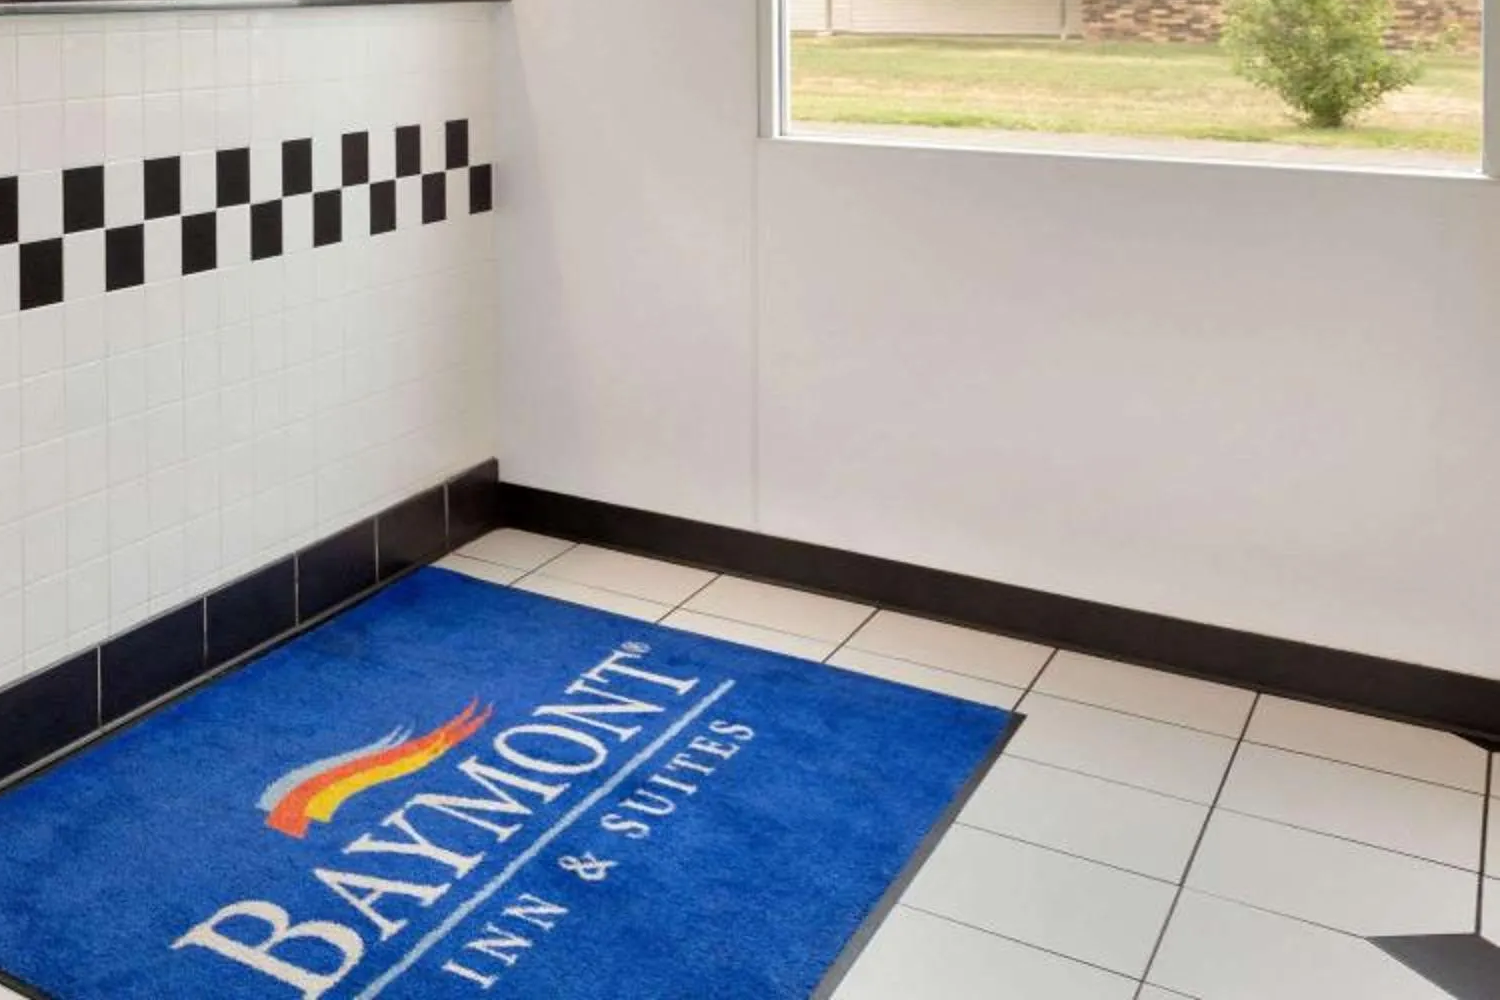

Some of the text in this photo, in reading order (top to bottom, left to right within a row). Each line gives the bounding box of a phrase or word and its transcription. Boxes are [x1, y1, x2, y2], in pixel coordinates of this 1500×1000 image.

[441, 719, 755, 989] INN & SUITES
